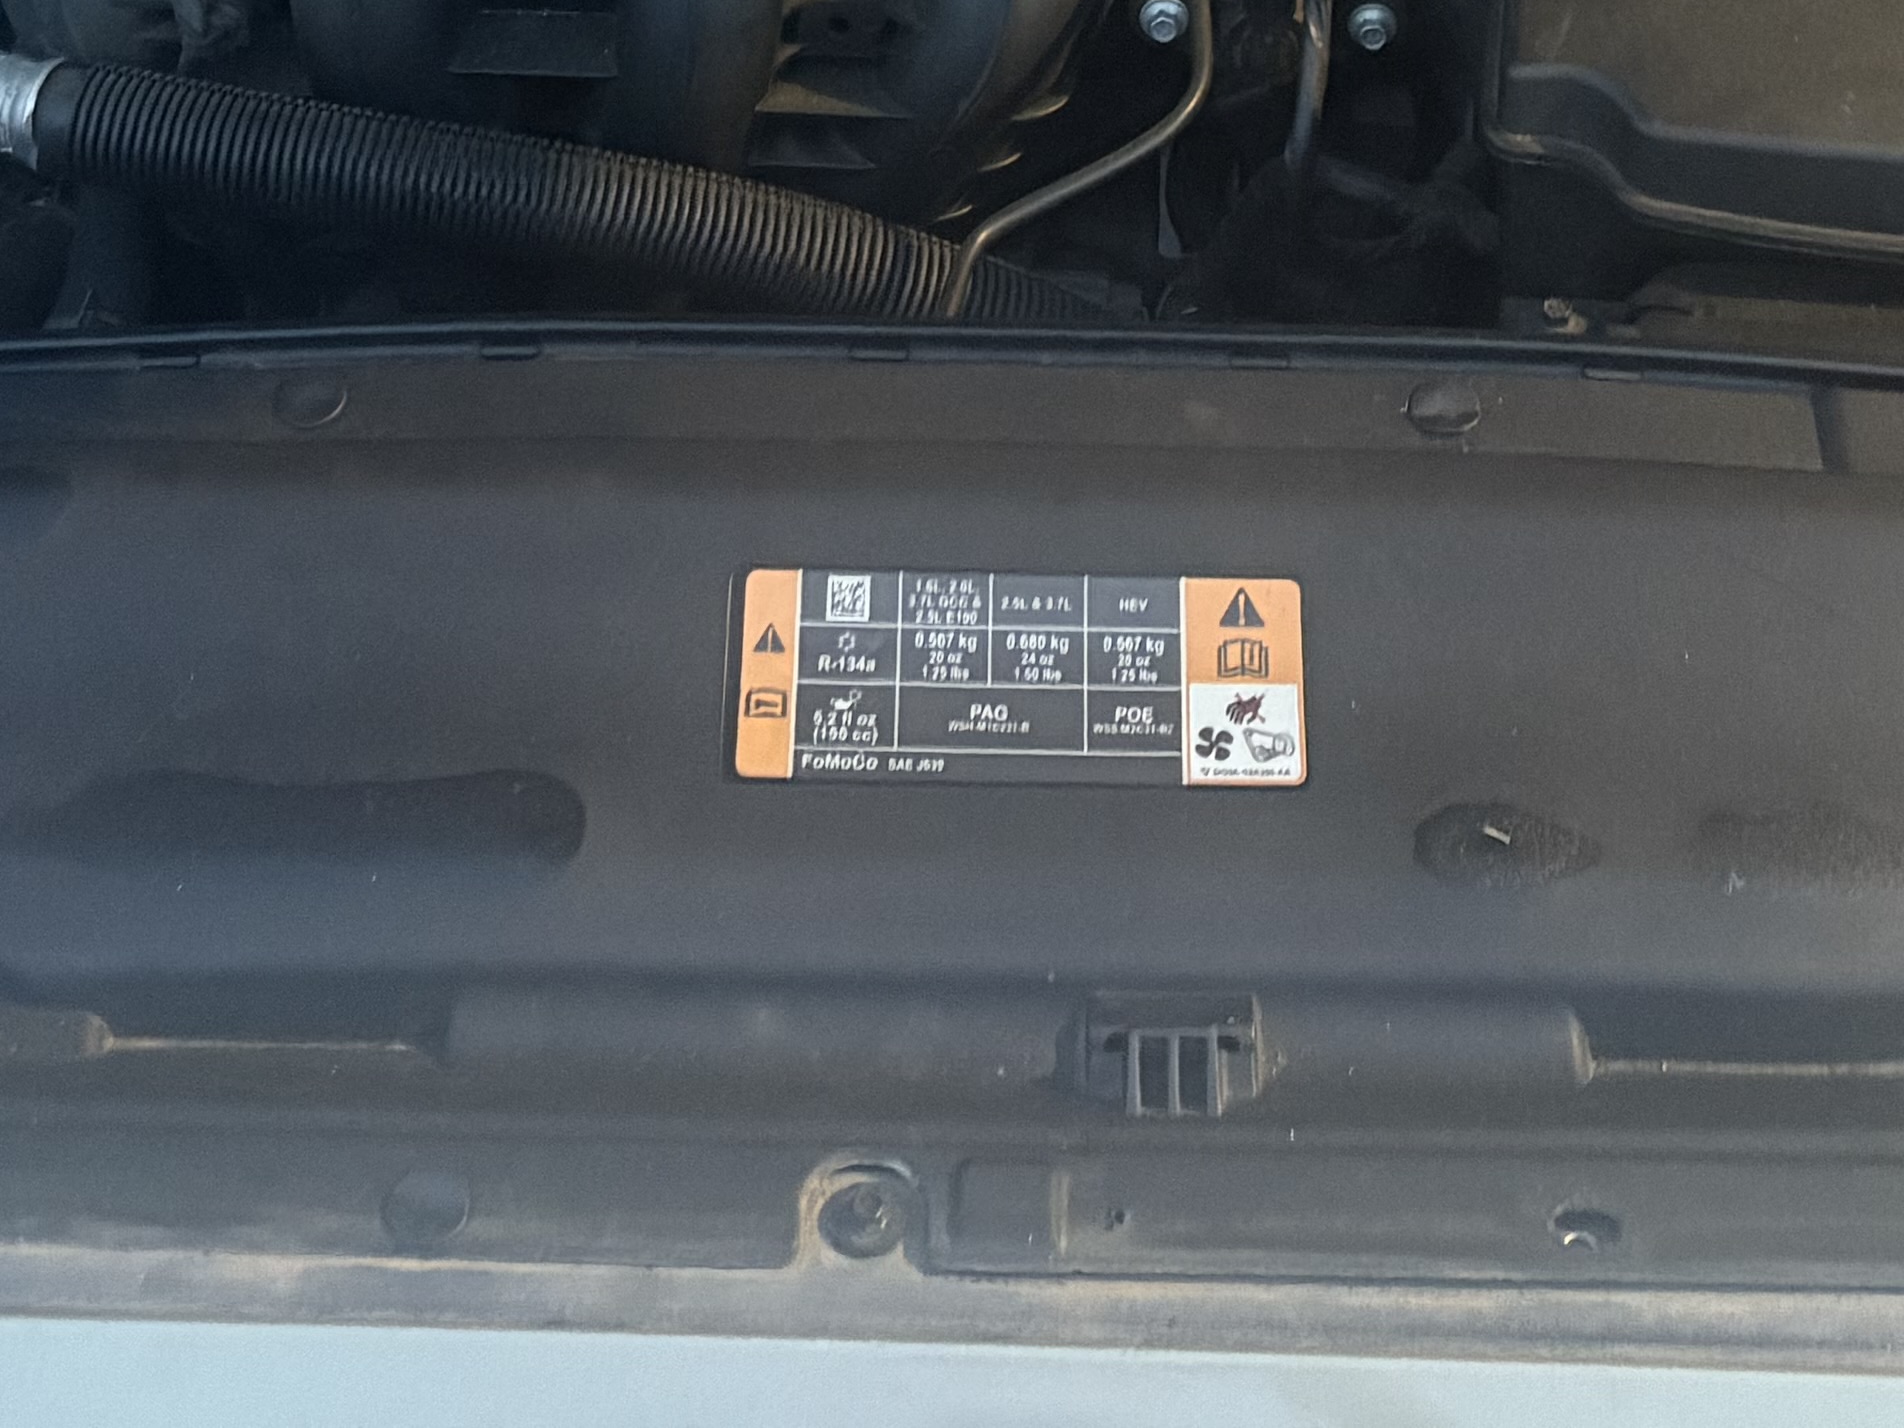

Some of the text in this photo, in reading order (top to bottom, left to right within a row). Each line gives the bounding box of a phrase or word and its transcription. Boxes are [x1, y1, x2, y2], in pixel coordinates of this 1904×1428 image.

[958, 631, 978, 654] kg
[1050, 634, 1070, 655] kg
[1145, 635, 1165, 657] kg
[817, 654, 877, 674] R-134a
[928, 650, 964, 664] 20 oz
[1020, 652, 1056, 666] 24 oz
[1117, 653, 1151, 667] 20 oz
[856, 713, 878, 727] oz
[969, 703, 1009, 722] PAG
[1114, 705, 1155, 724] POE
[852, 726, 880, 746] cc)
[801, 751, 879, 771] FoMoCo
